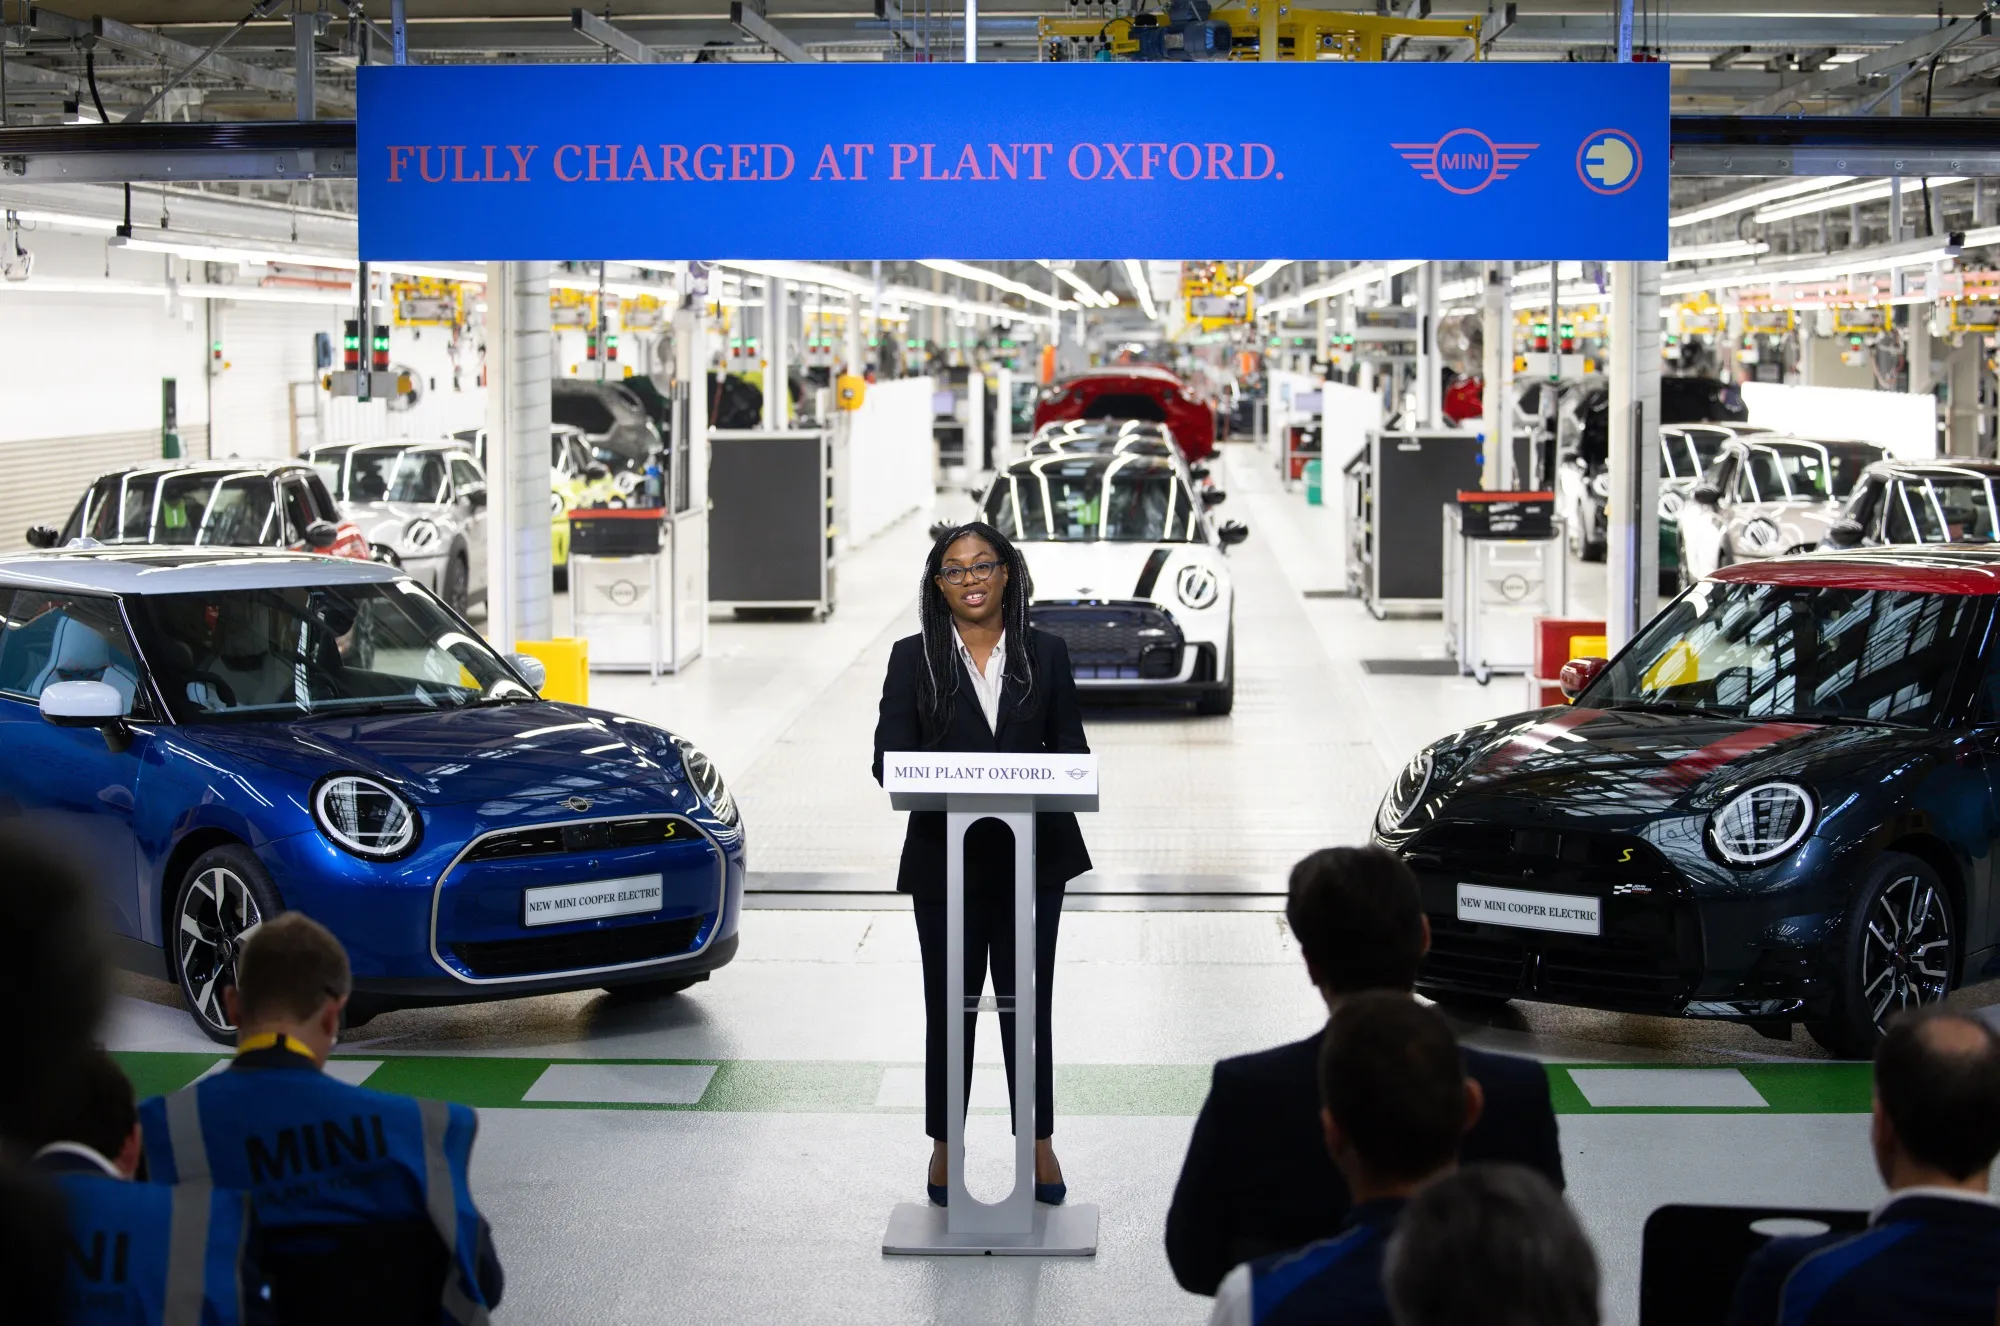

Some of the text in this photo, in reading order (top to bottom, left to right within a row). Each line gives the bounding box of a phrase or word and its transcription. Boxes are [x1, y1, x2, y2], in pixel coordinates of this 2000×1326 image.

[386, 142, 1285, 183] FULLY CHARGED AT PLANT OXFORD.
[1441, 153, 1489, 170] MINI
[894, 766, 1055, 781] MINI PLANT OXFORD.
[664, 822, 676, 838] S
[1617, 848, 1635, 863] S
[529, 887, 661, 913] NEW MINI COOPER ELECTRIC
[1460, 897, 1597, 922] NEW MINI COOPER ELECTRIC
[244, 1113, 389, 1185] MINI
